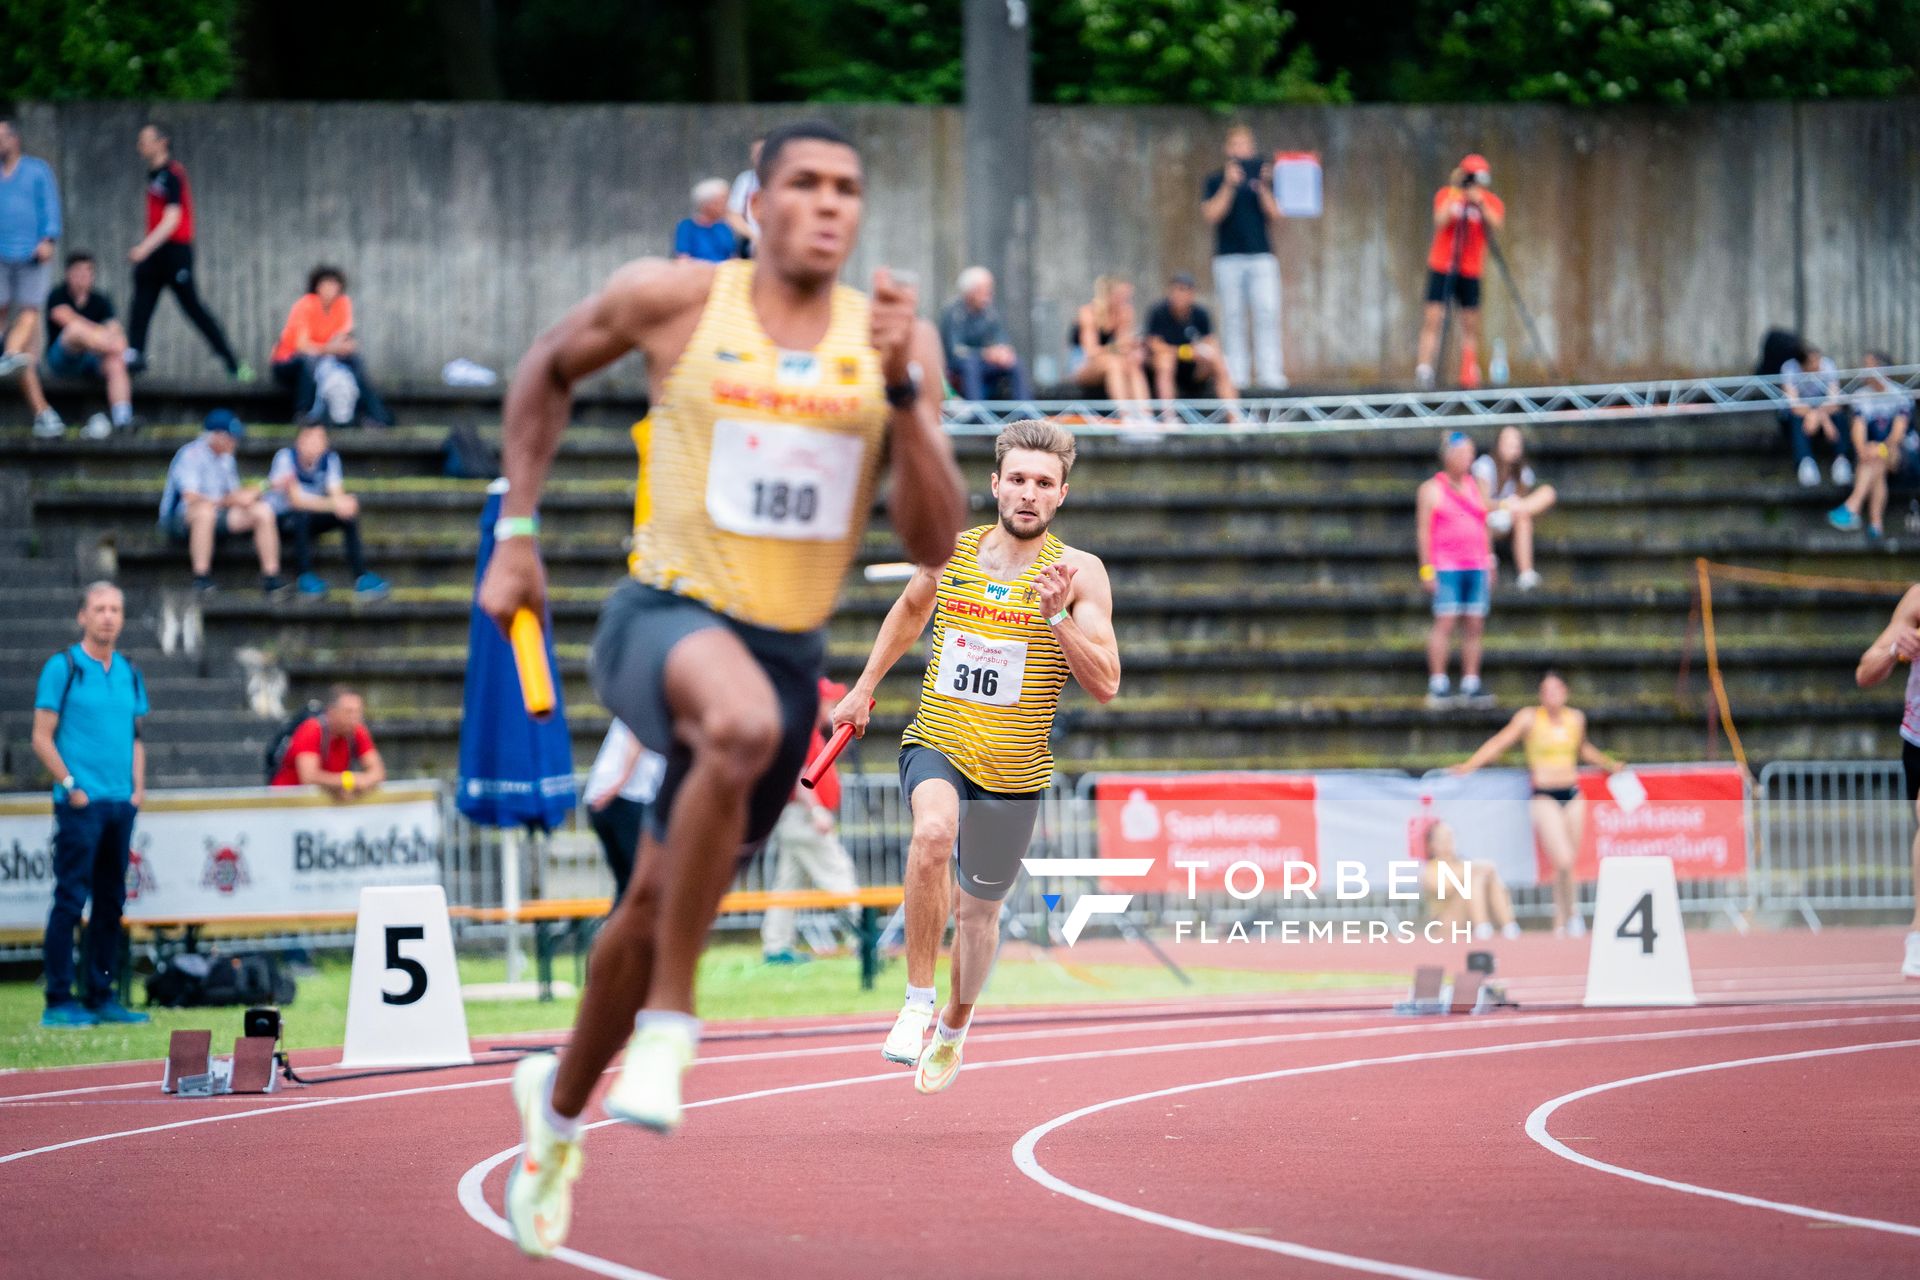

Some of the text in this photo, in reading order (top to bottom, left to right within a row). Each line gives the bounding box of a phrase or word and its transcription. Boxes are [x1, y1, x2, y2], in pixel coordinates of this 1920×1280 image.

[752, 478, 819, 522] 180
[987, 583, 1010, 600] wgv
[945, 598, 1033, 626] GERMANY
[967, 652, 1008, 667] Regensburg
[968, 642, 1002, 655] Sparkasse
[953, 663, 999, 697] 316
[1616, 890, 1658, 954] 4
[382, 926, 428, 1005] 5
